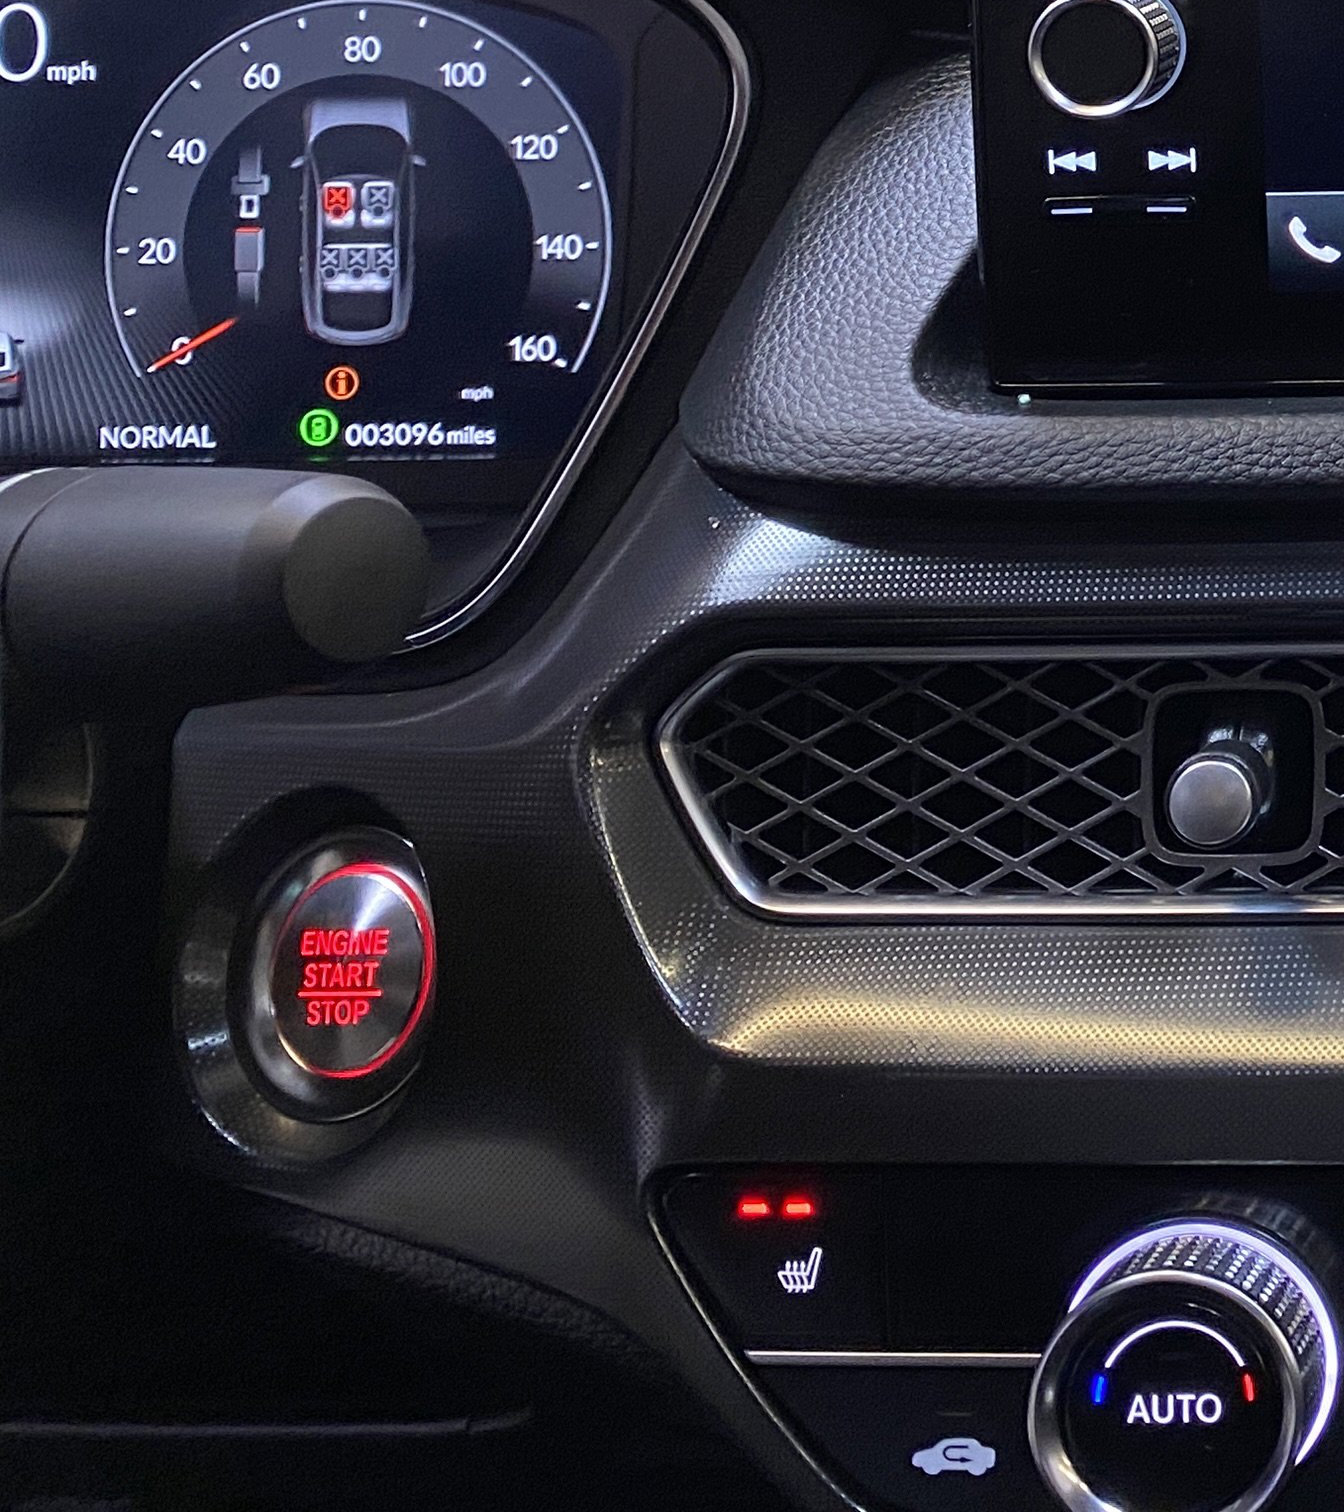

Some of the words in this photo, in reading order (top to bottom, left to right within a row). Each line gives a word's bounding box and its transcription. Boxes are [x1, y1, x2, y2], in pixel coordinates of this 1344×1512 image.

[0, 2, 48, 83] 0
[46, 61, 97, 83] mph
[344, 36, 381, 62] 80
[244, 63, 281, 89] 60
[440, 62, 486, 87] 100
[167, 139, 207, 164] 40
[509, 133, 558, 161] 120
[138, 238, 176, 264] 20
[534, 233, 583, 260] 140
[507, 335, 557, 363] 160
[460, 386, 494, 401] mph
[99, 425, 216, 450] NORMAL
[344, 425, 444, 448] 003096
[446, 426, 496, 447] miles
[301, 928, 390, 956] ENGINE
[303, 962, 379, 987] START
[307, 999, 370, 1025] STOP
[1127, 1393, 1222, 1424] AUTO
